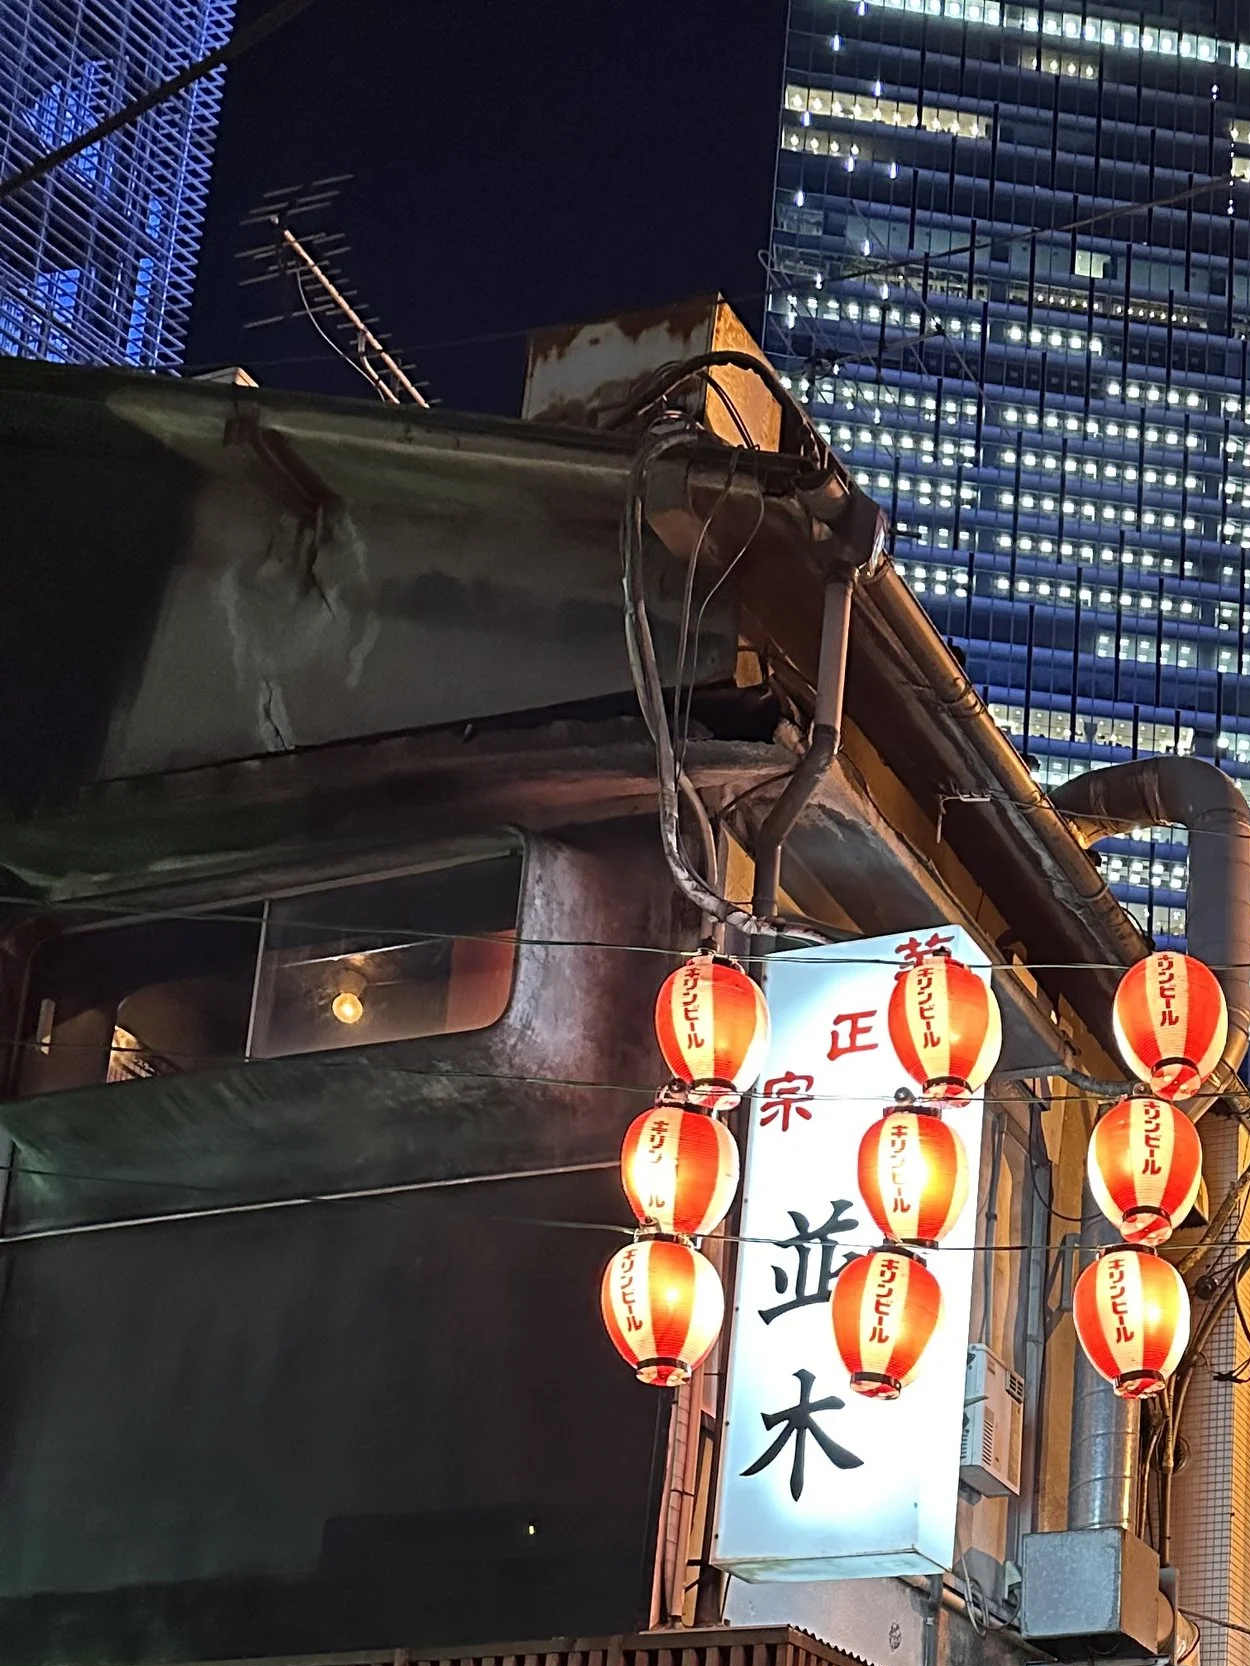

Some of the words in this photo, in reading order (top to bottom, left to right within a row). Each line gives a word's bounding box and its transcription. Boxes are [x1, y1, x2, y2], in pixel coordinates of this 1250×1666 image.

[683, 966, 705, 1050] キリンビール
[916, 966, 942, 1050] キリンビール
[1142, 1100, 1162, 1177] キリンビール
[622, 1247, 644, 1334] キリンビール
[868, 1257, 903, 1345] キリンビール
[1107, 1257, 1136, 1345] キリンビール
[740, 1199, 864, 1503] 並木
